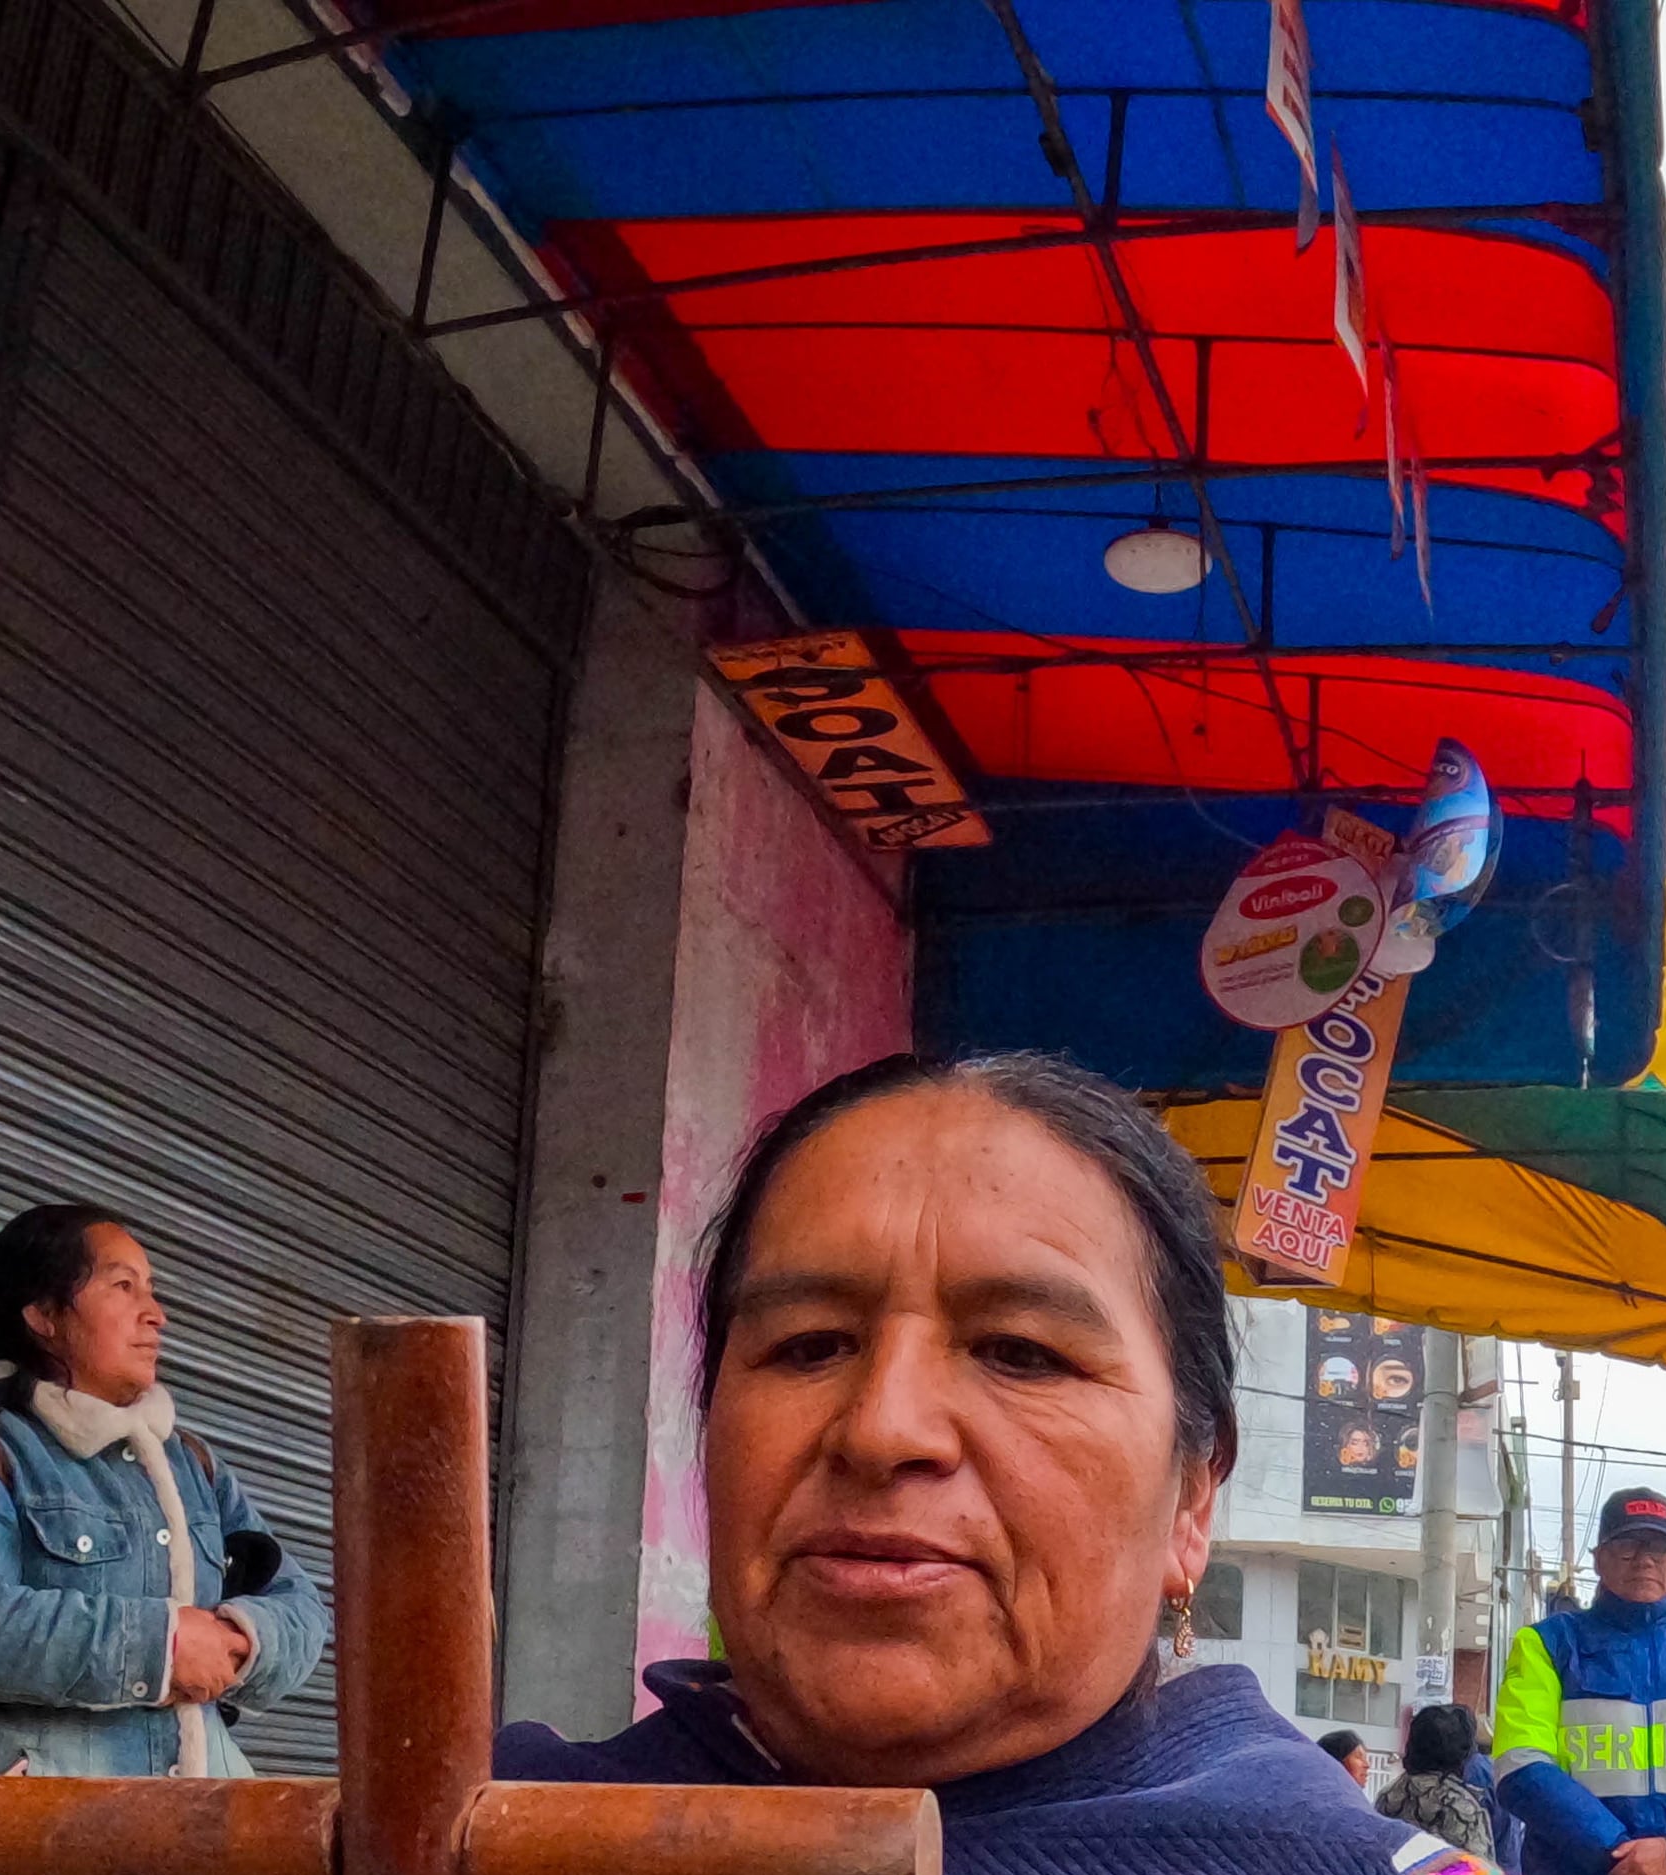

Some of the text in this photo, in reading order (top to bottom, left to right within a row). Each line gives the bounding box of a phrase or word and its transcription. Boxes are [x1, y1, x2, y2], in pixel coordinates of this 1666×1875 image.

[1273, 969, 1386, 1204] FOCAT
[1251, 1183, 1347, 1247] VENTA
[1253, 1224, 1335, 1270] AQUÍ
